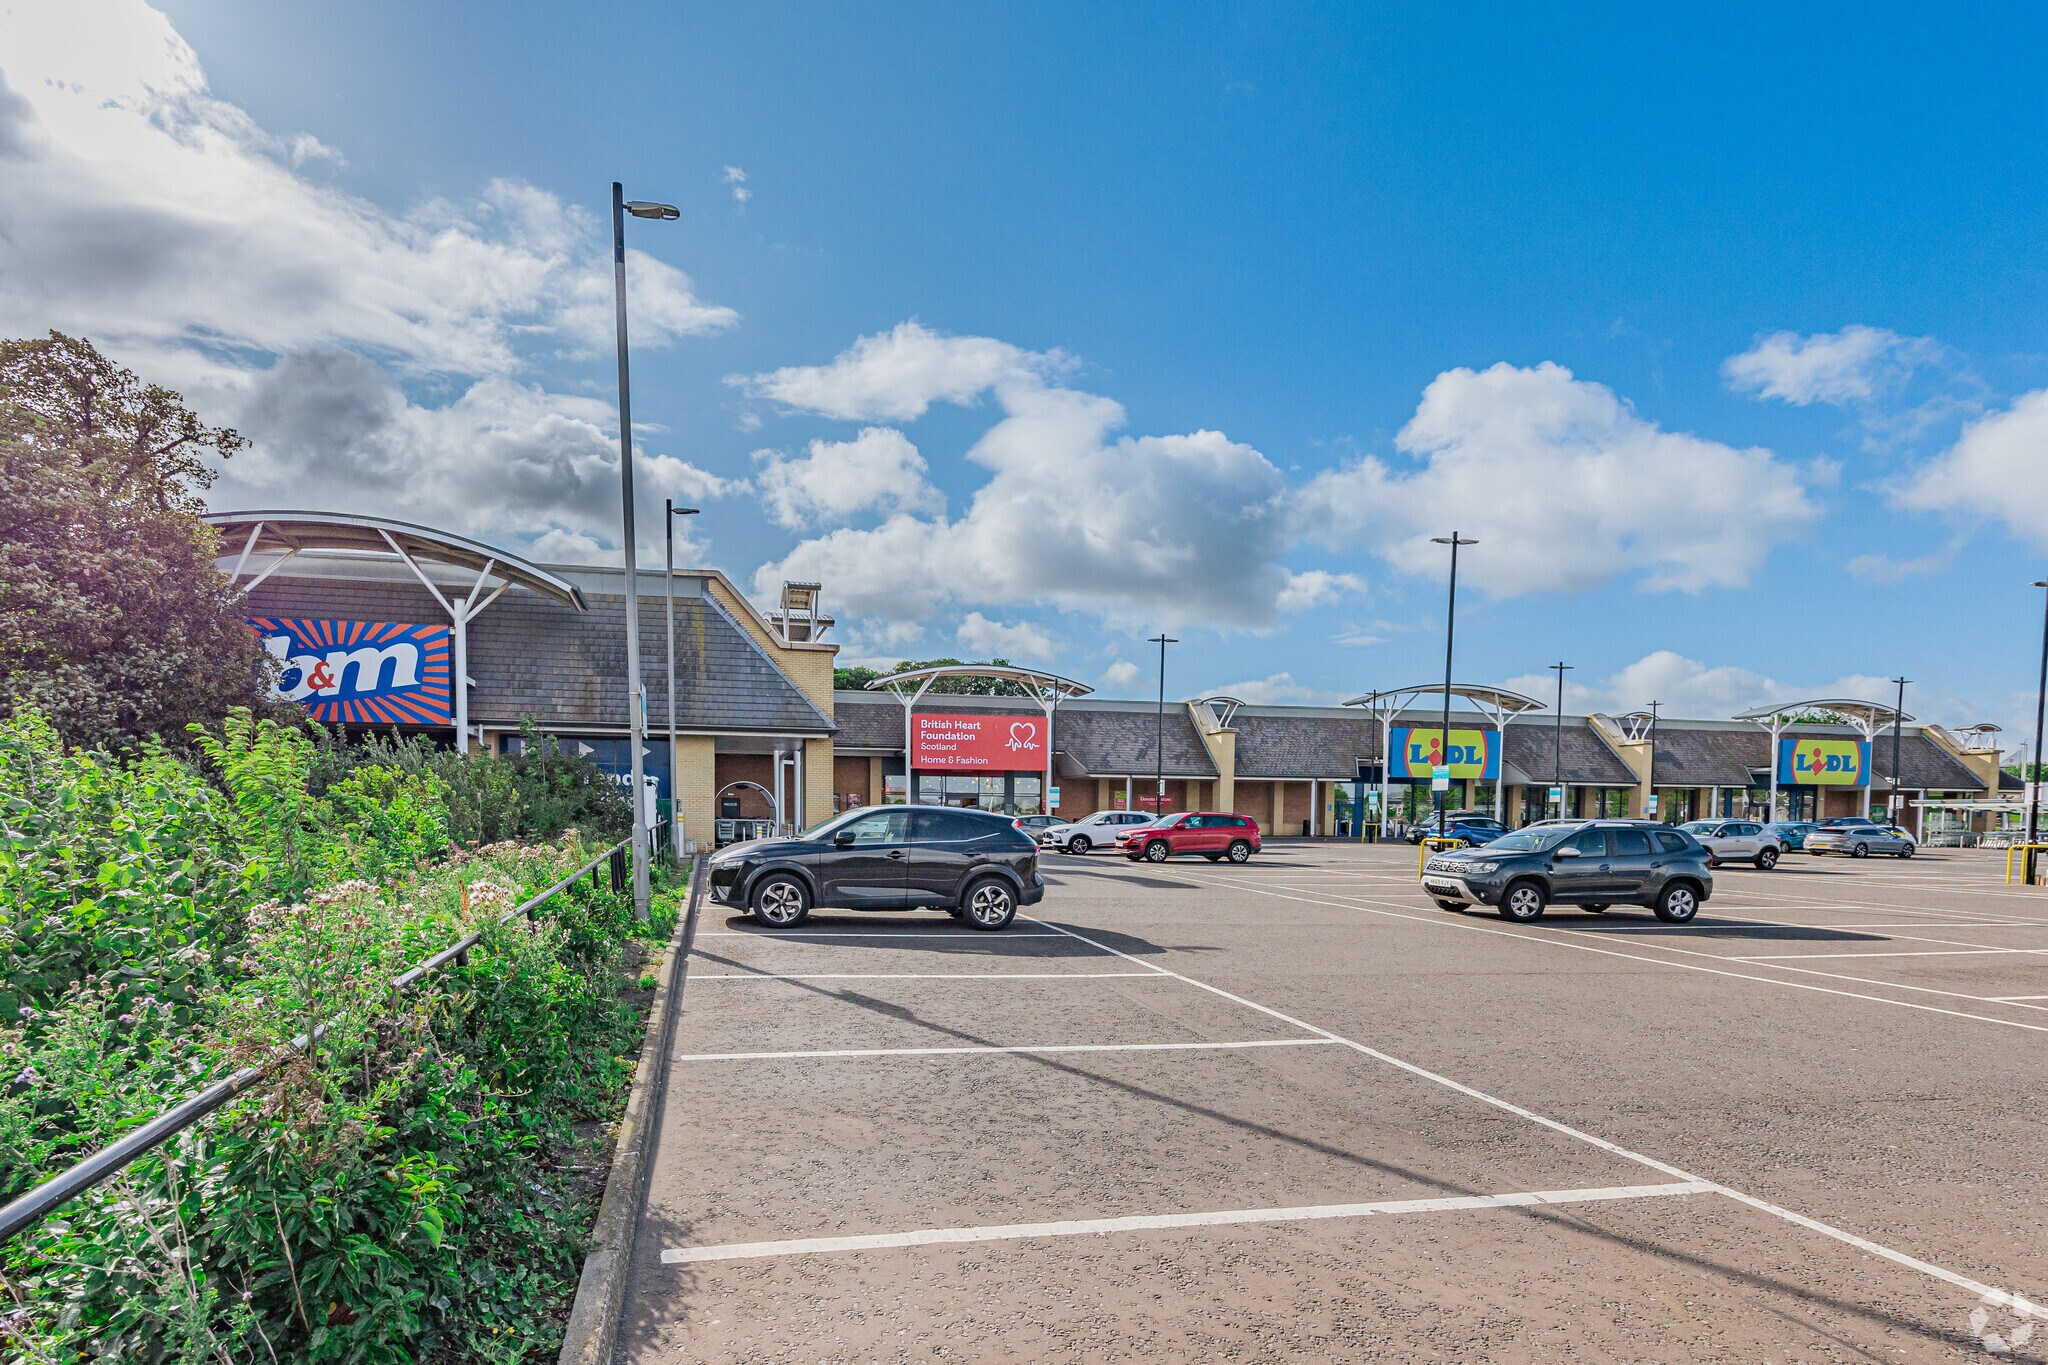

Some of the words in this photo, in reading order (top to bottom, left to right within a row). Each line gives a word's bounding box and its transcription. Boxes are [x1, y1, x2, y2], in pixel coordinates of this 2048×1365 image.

[920, 720, 952, 729] British
[954, 721, 981, 730] Heart
[920, 731, 976, 741] Foundation
[920, 742, 957, 751] Scotland
[920, 755, 946, 764] Home
[948, 756, 954, 764] &
[955, 756, 989, 765] Fashion
